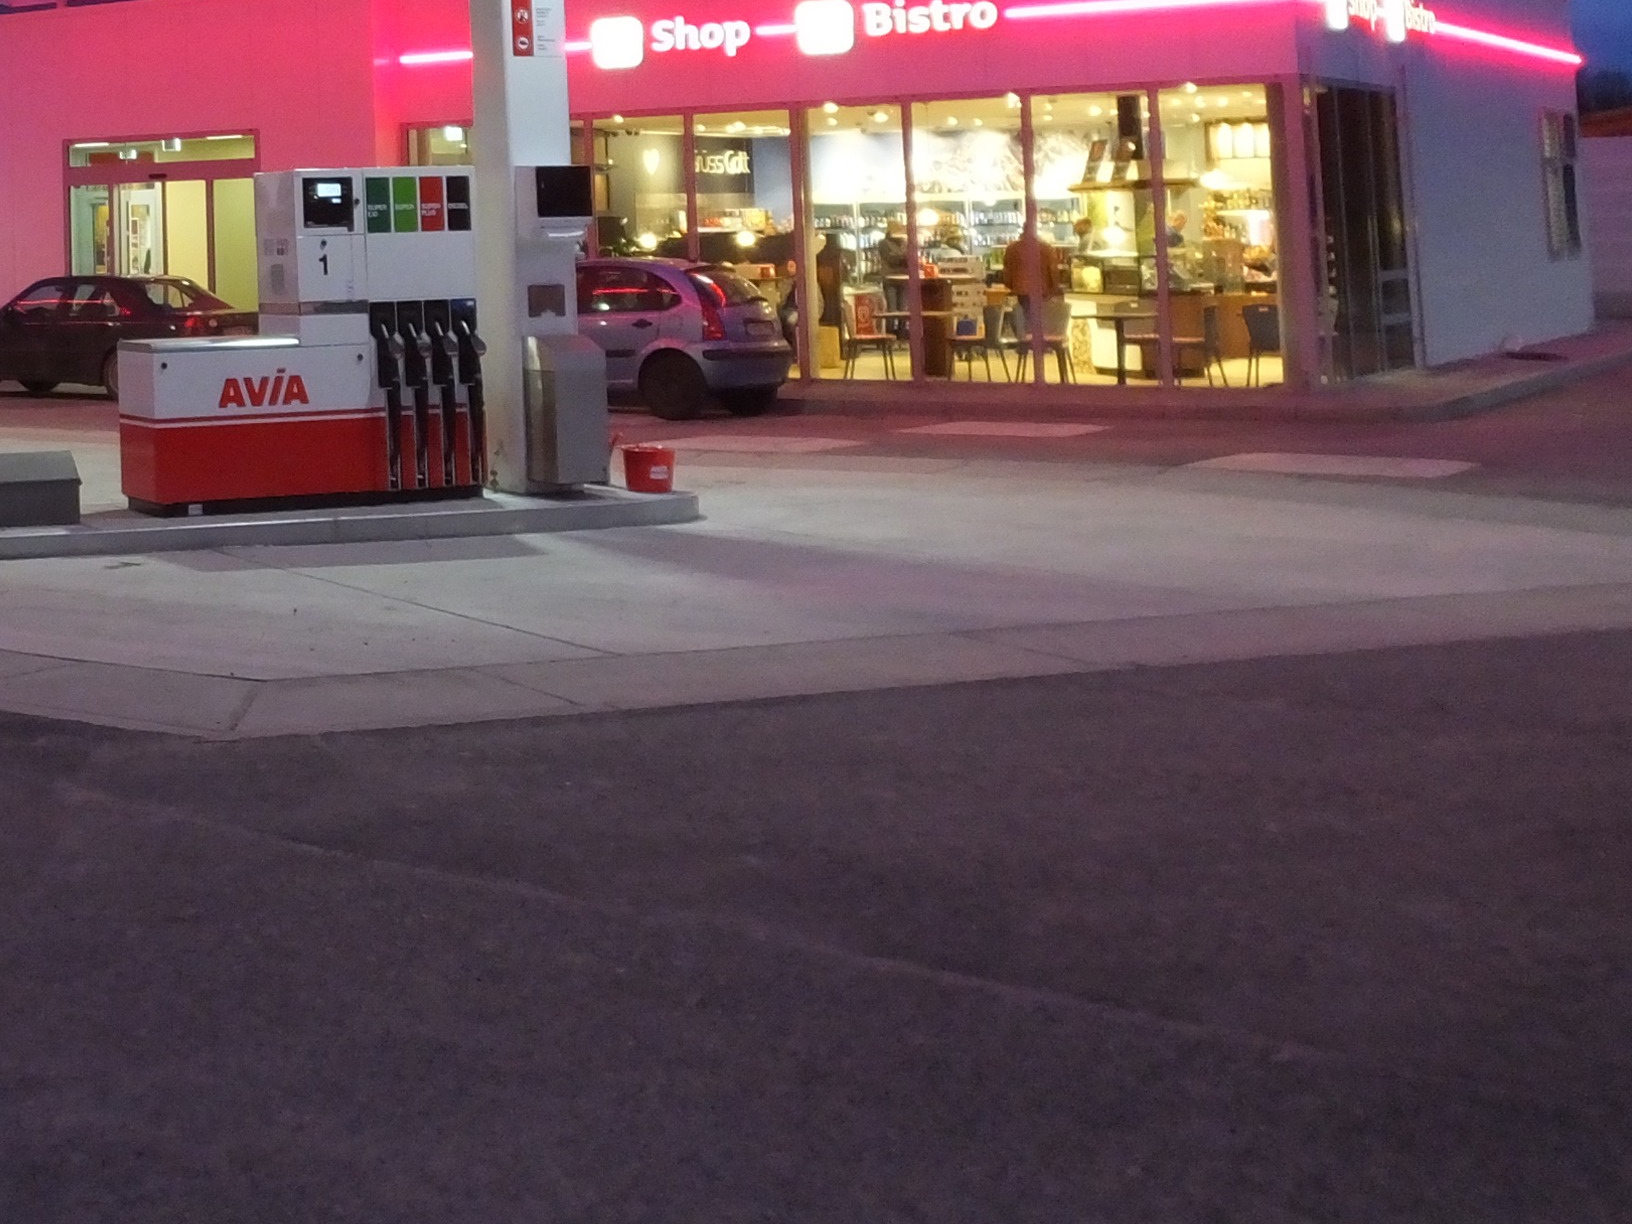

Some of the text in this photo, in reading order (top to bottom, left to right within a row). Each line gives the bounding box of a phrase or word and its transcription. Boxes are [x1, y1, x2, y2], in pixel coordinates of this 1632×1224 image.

[651, 15, 751, 57] Shop
[318, 254, 329, 276] 1
[218, 367, 310, 408] AVIA
